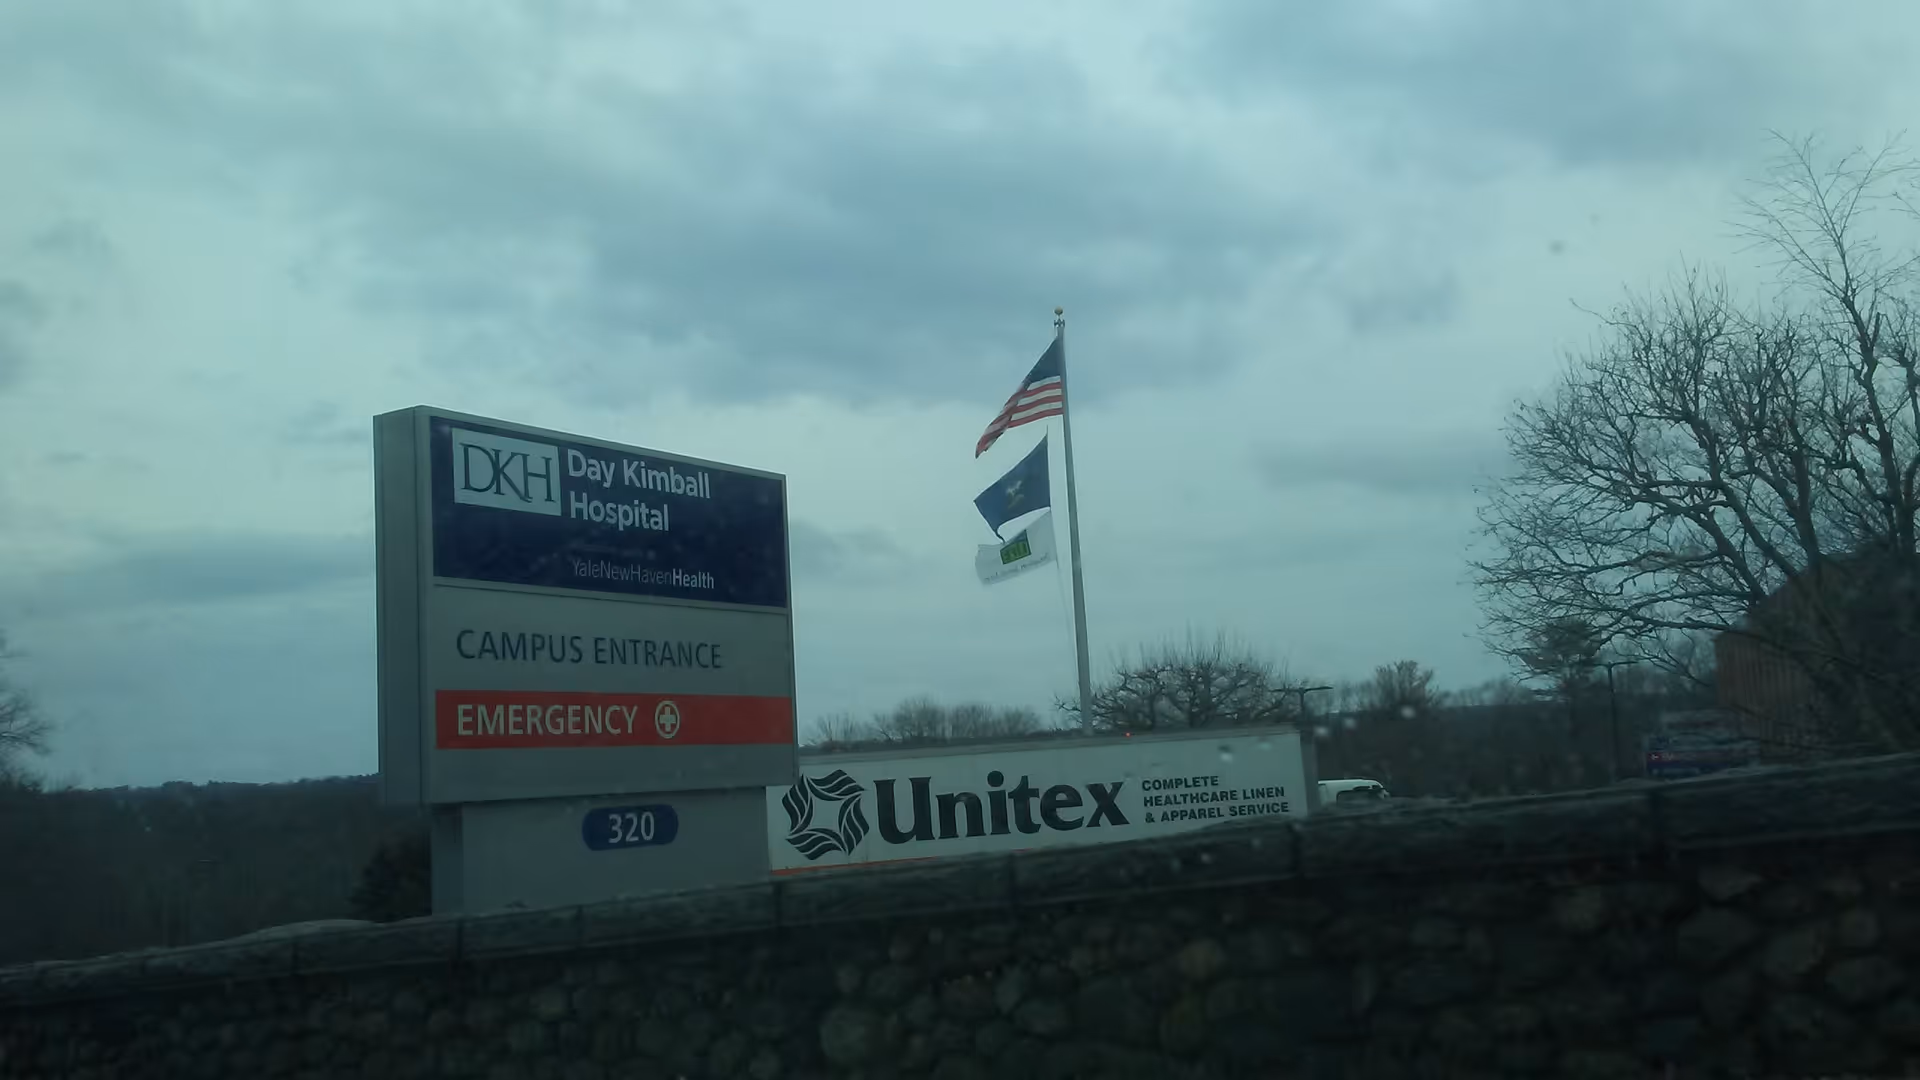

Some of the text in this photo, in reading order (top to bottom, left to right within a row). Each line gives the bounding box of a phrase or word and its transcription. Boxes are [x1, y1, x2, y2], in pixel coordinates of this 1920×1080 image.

[460, 443, 556, 503] DKH
[568, 448, 710, 499] Day Kimball
[571, 491, 669, 531] Hospital
[457, 629, 722, 668] CAMPUS ENTRANCE
[457, 704, 638, 735] EMERGENCY
[1142, 775, 1219, 791] COMPLETE
[1144, 786, 1285, 807] HEALTHCARE LINEN
[873, 770, 1130, 844] Unitex
[1145, 802, 1290, 823] & APPAREL SERVICE
[608, 811, 655, 843] 320
